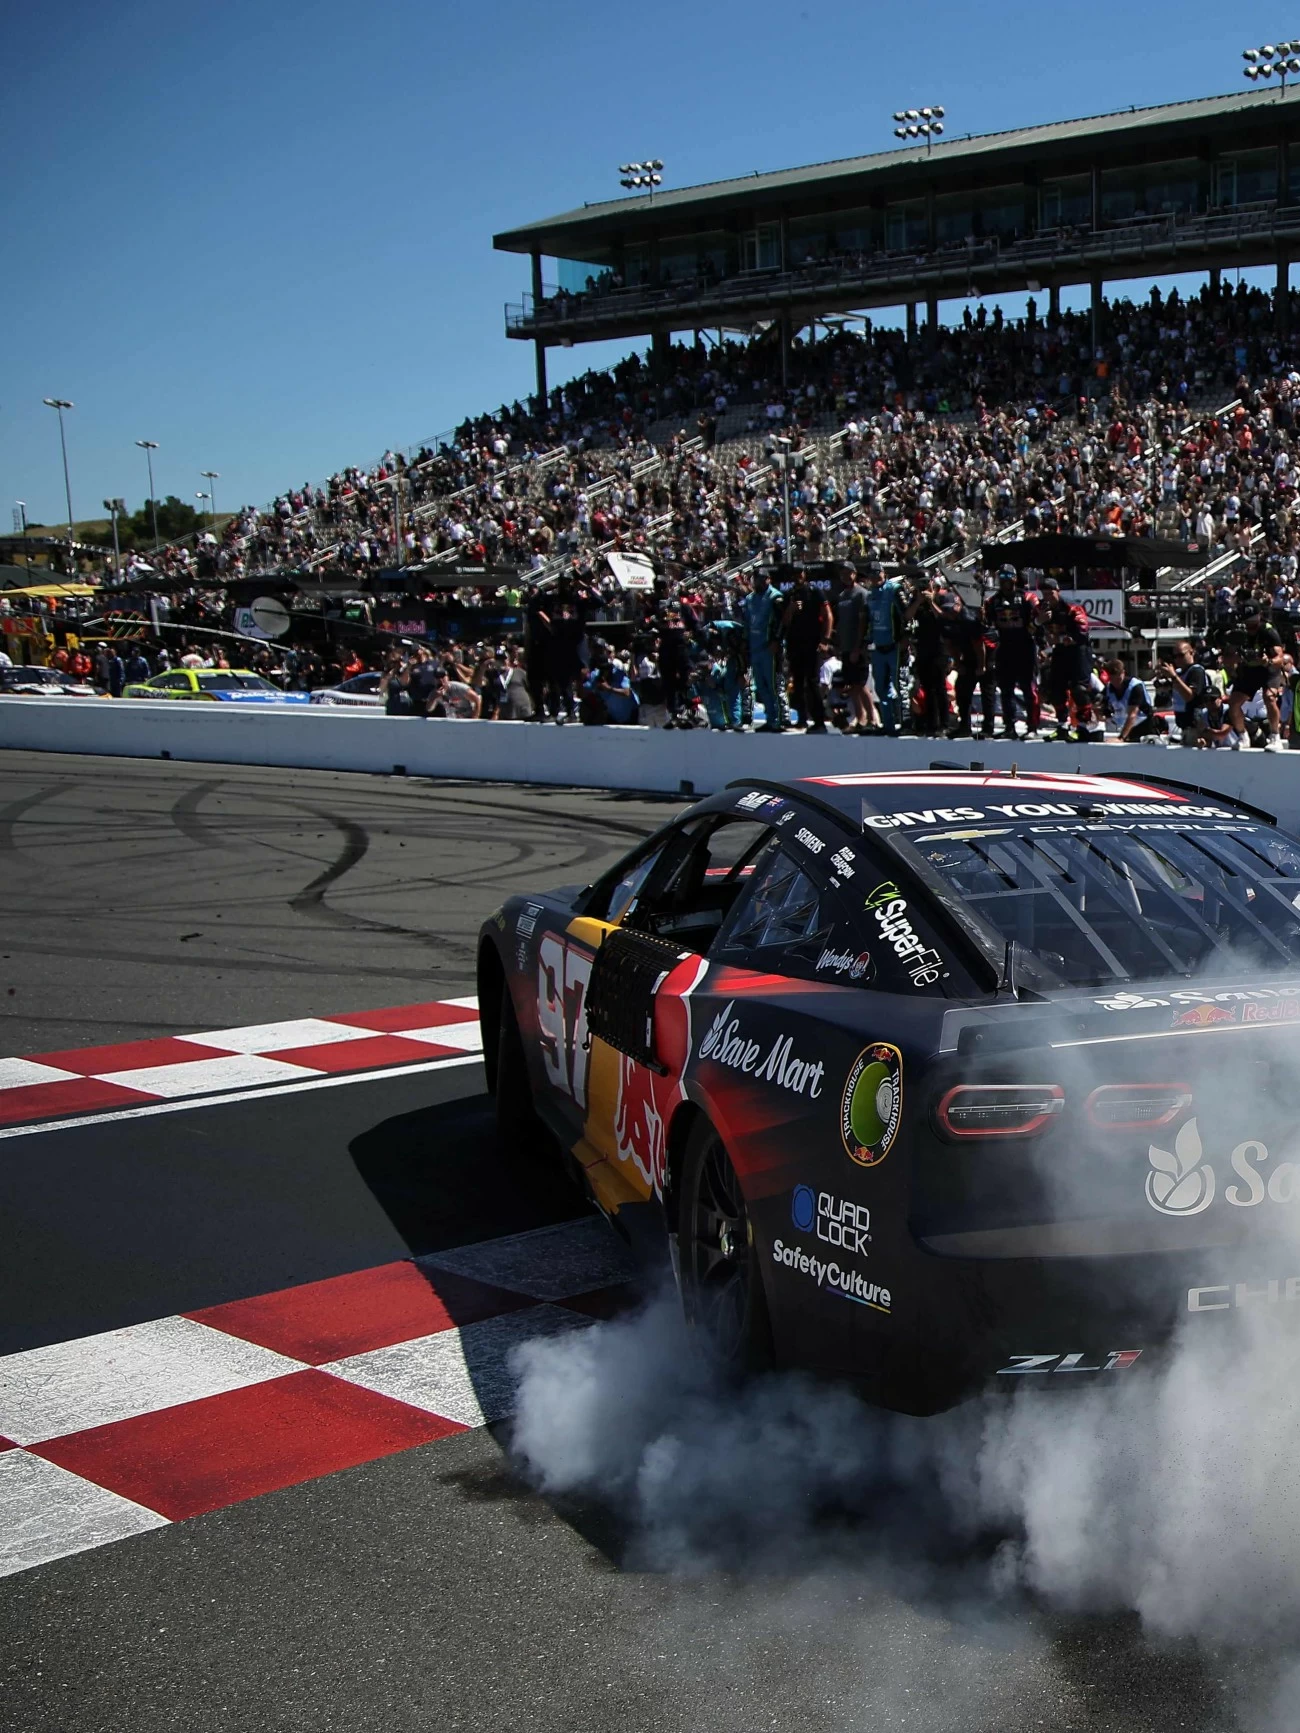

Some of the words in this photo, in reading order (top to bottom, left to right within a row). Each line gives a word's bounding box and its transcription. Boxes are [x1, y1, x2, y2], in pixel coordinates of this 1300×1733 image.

[863, 807, 985, 828] GIVES
[985, 803, 1077, 817] YOU
[1030, 823, 1259, 833] CHEVROLET
[794, 827, 826, 854] SIEMENS
[816, 948, 854, 975] Wendy's
[537, 933, 594, 1110] 97
[1242, 1000, 1284, 1022] Red
[711, 1019, 760, 1073] Save
[754, 1033, 825, 1099] Mart
[843, 1058, 865, 1140] TRACKHOUSE
[880, 1068, 899, 1151] TRACKHOUSE
[818, 1192, 870, 1231] QUAD
[816, 1215, 868, 1257] LOCK
[773, 1239, 891, 1307] SafetyCulture
[996, 1349, 1144, 1375] ZL1
